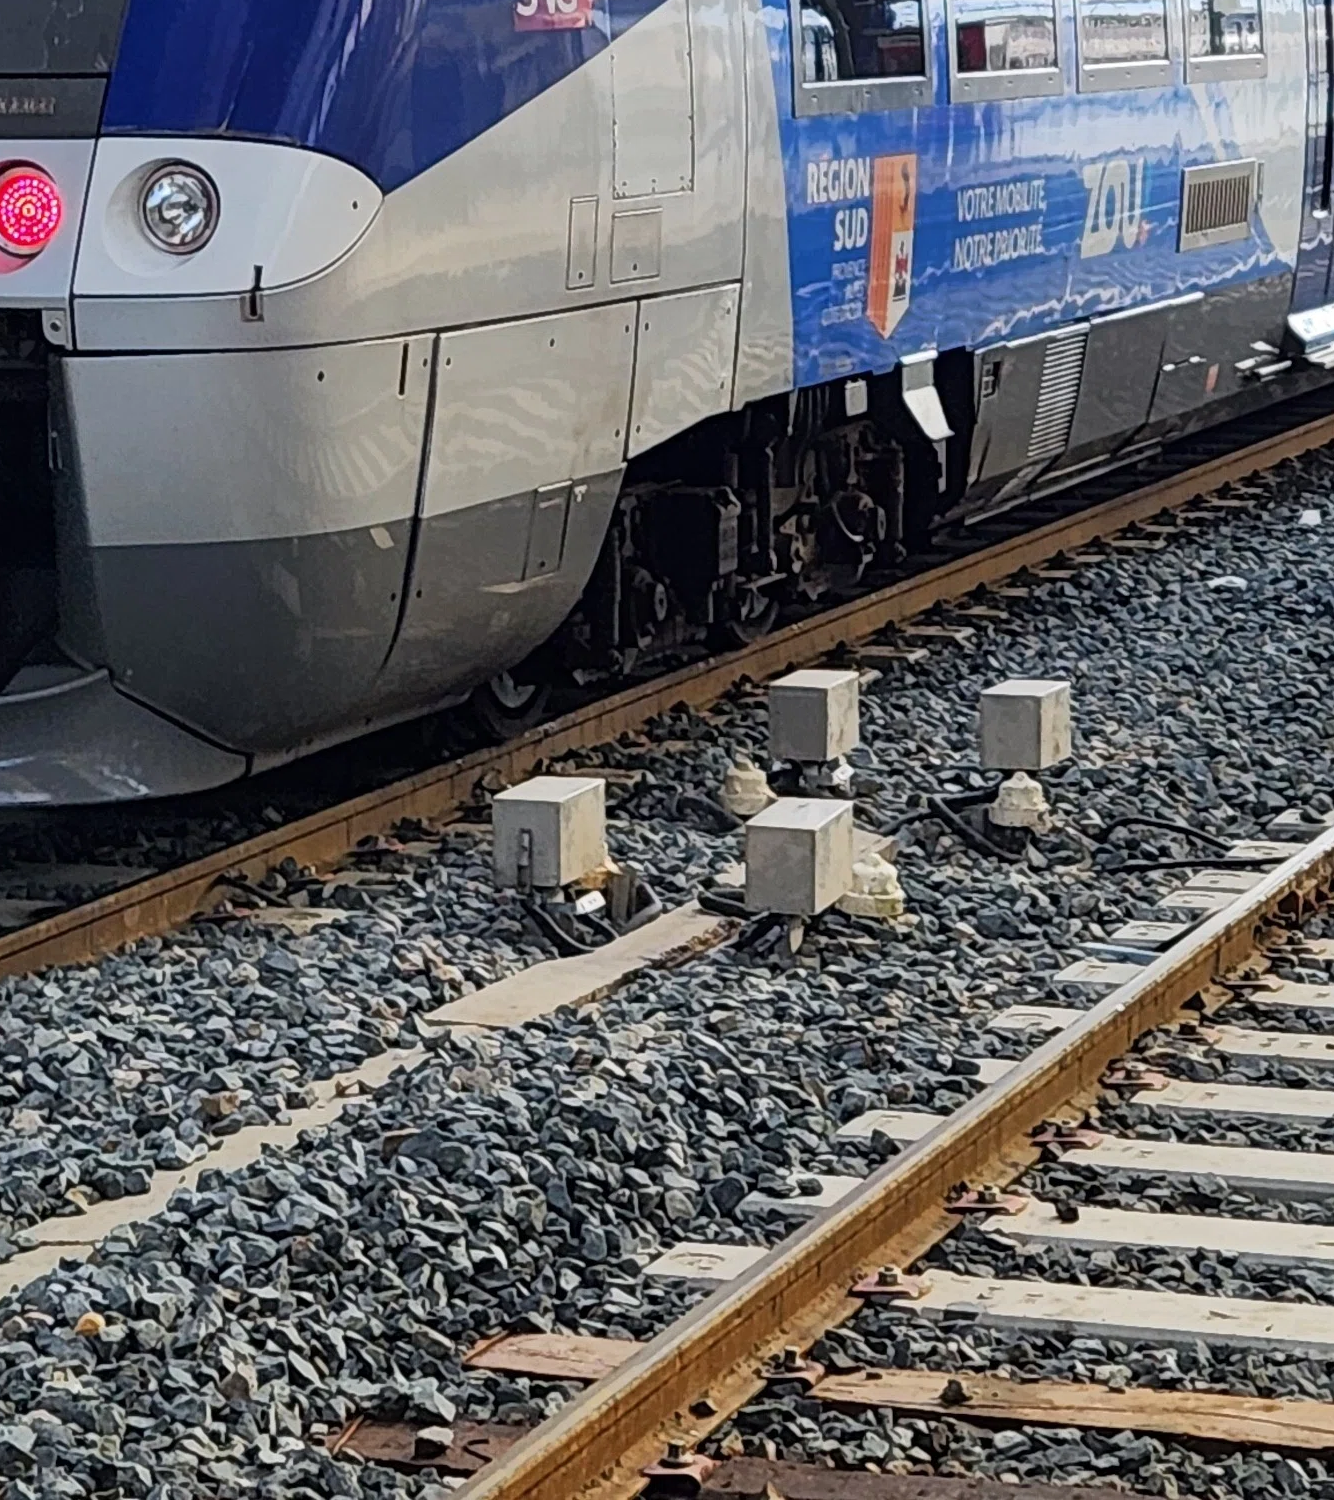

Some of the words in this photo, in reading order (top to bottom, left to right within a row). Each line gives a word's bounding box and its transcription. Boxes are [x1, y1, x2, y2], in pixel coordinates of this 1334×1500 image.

[807, 153, 871, 204] RÉGION
[957, 185, 995, 222] VOTRE
[833, 207, 869, 251] SUD
[954, 232, 994, 271] NOTRE
